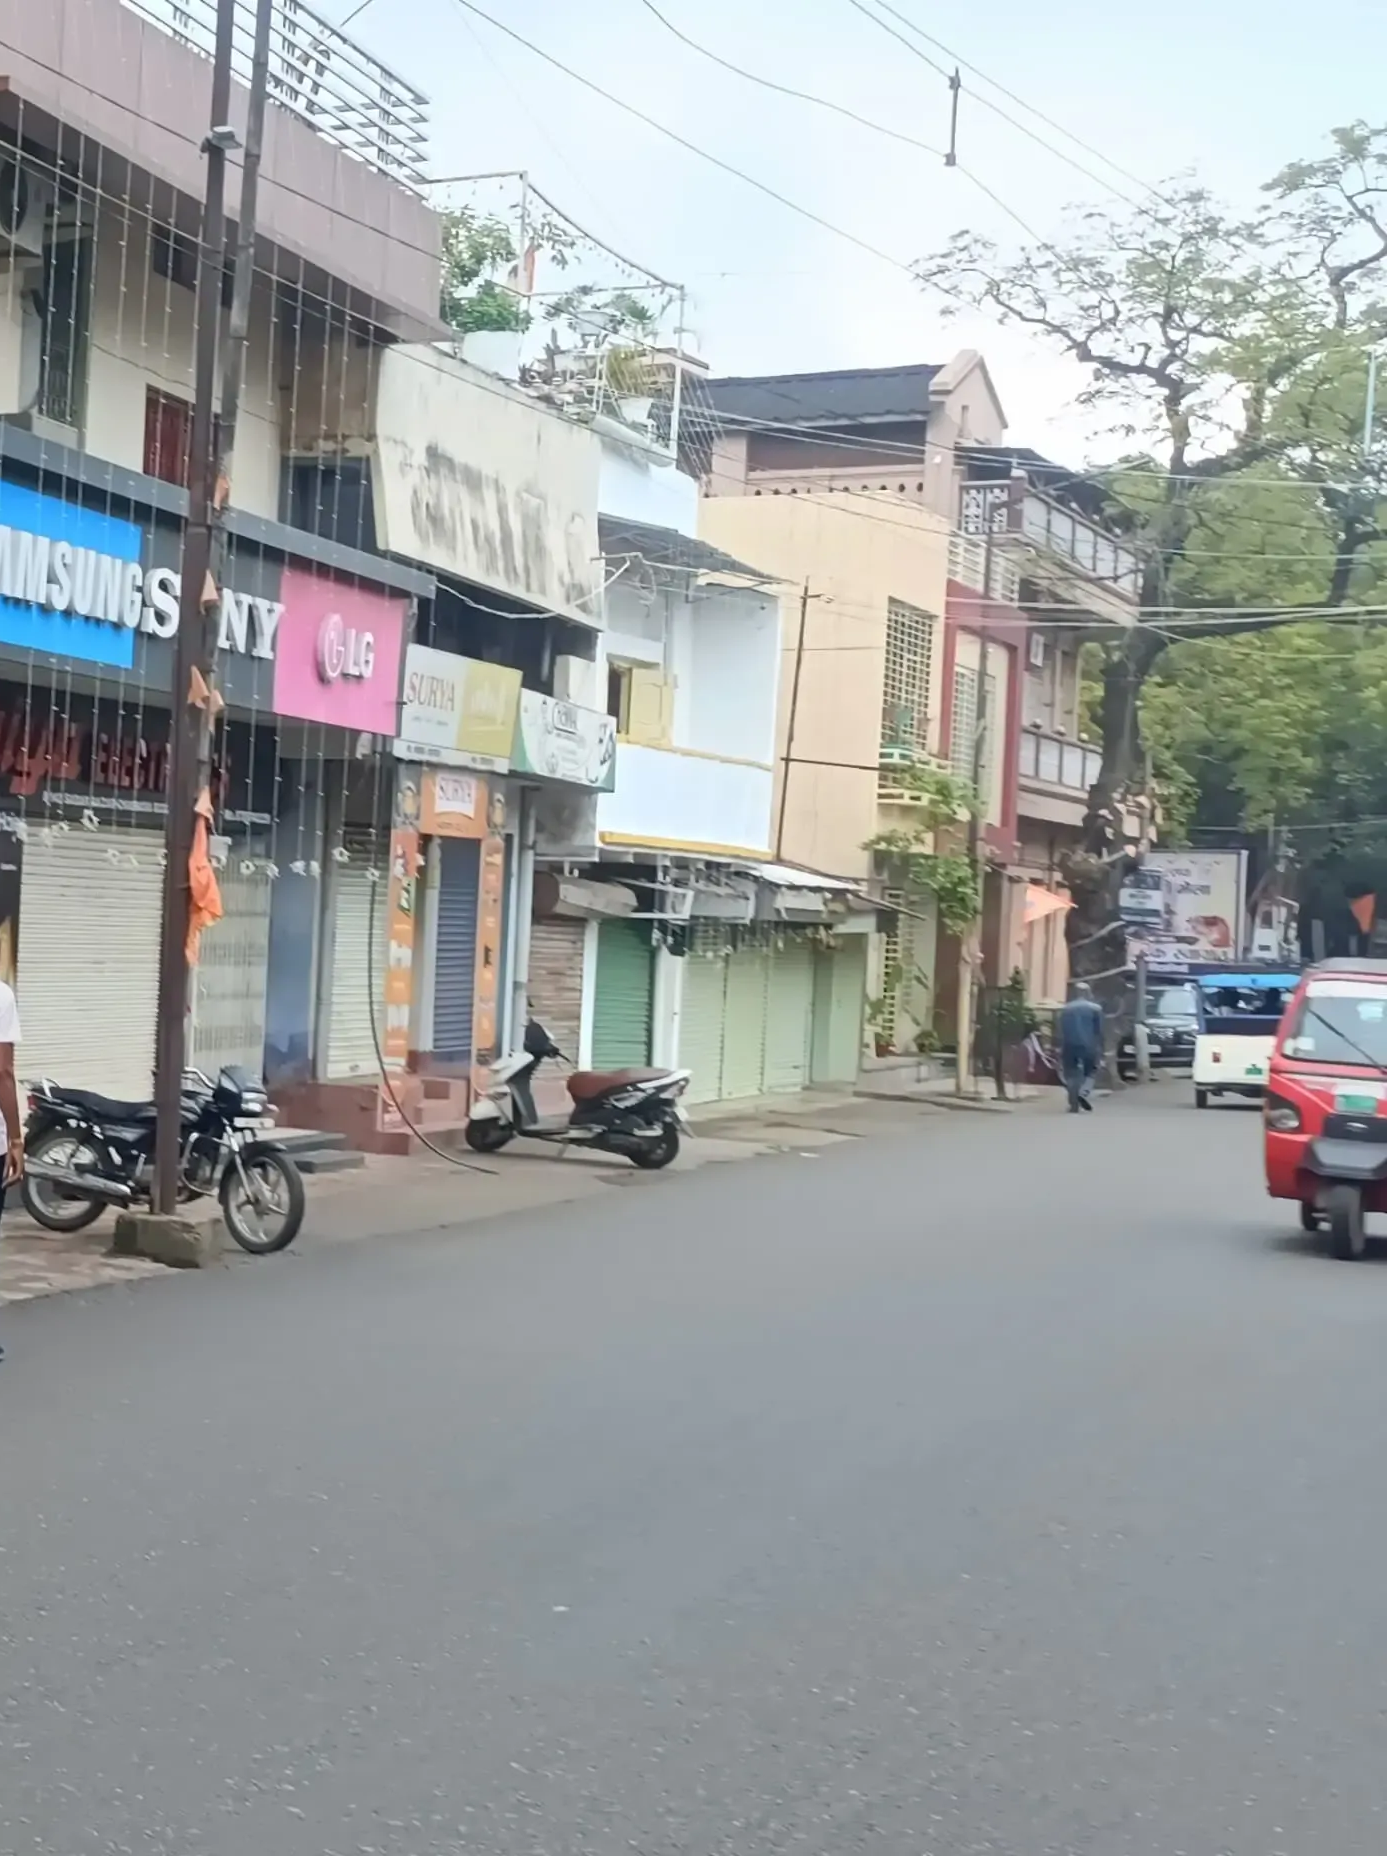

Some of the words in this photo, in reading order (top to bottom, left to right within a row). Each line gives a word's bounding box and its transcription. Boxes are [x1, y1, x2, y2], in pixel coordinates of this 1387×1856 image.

[141, 567, 286, 660] SNY
[342, 628, 374, 679] LG
[406, 672, 456, 713] SURYA
